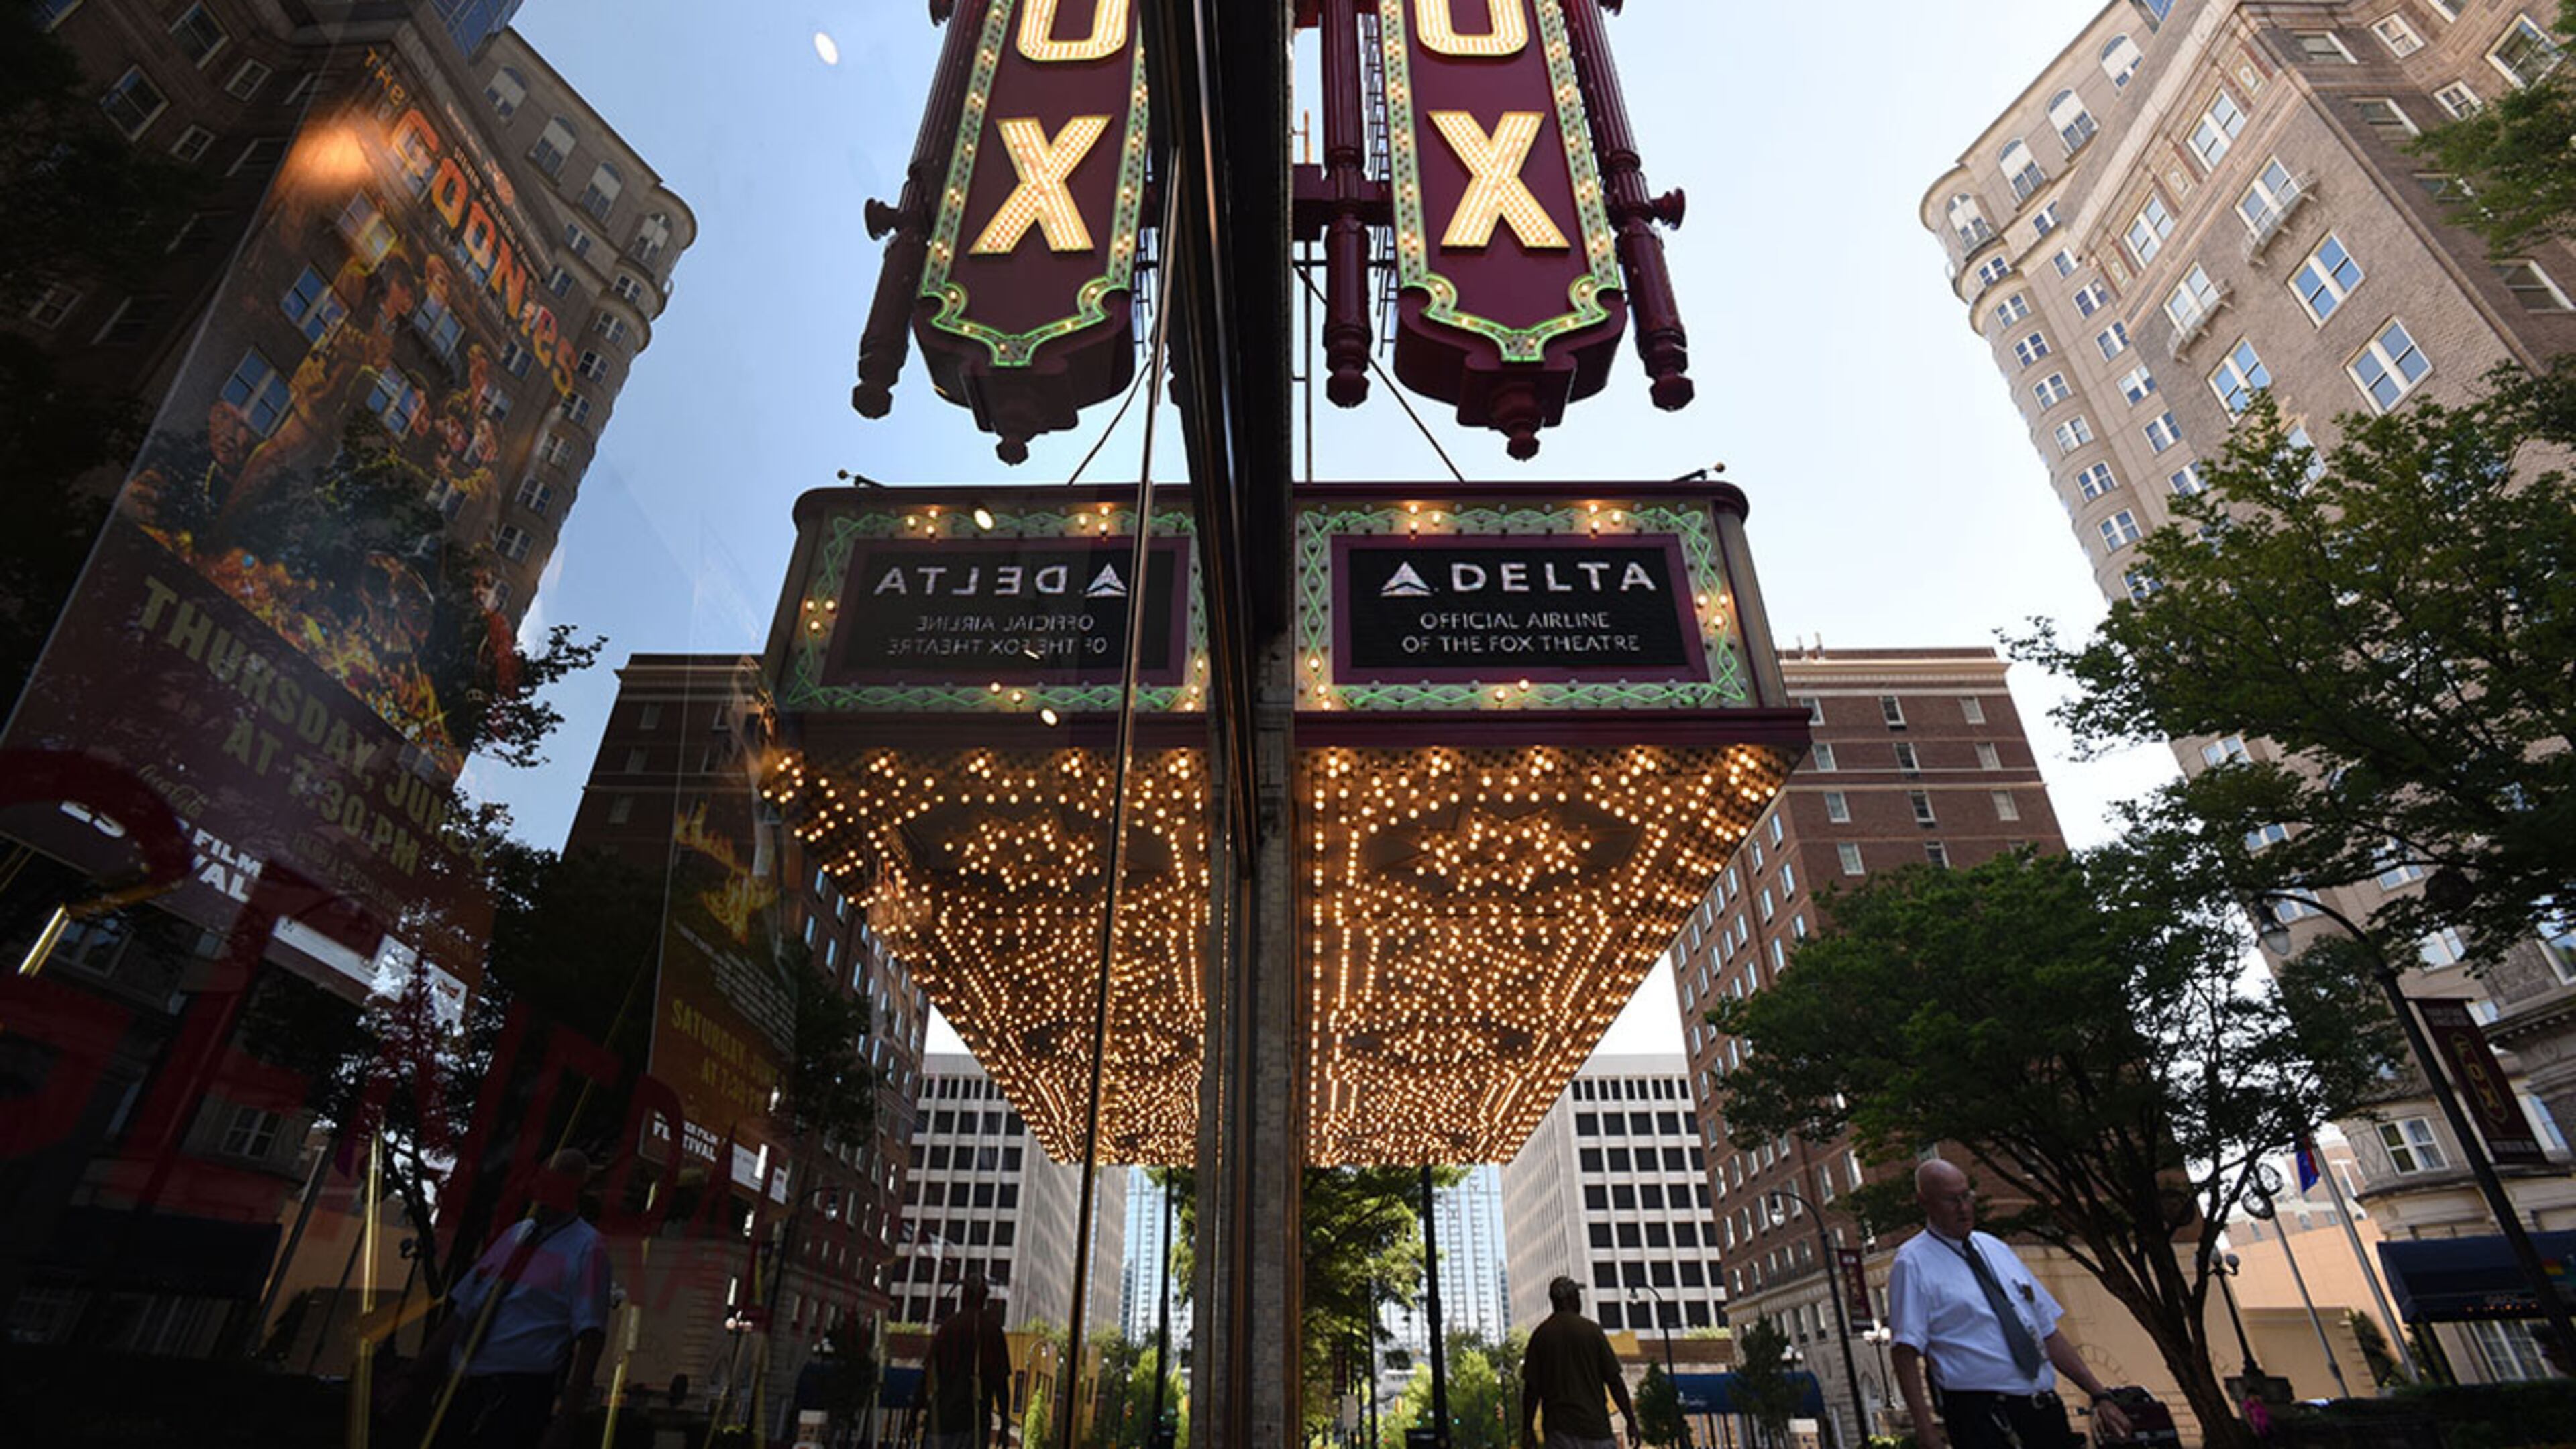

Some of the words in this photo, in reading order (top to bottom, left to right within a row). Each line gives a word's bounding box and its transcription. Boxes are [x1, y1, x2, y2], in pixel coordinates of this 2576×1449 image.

[363, 46, 406, 108] THE
[1451, 562, 1657, 592] DELTA
[1402, 635, 1430, 653] OF
[1439, 635, 1483, 653] THE
[1489, 635, 1535, 652] FOX
[1540, 634, 1640, 652] THEATRE
[1420, 611, 1519, 630] OFFICIAL
[1525, 611, 1611, 629] AIRLINE
[137, 575, 380, 792] THURSDAY,
[222, 718, 282, 776] AT
[370, 812, 421, 877] PM
[193, 828, 264, 879] FILM
[651, 1120, 718, 1164] FETIVAL
